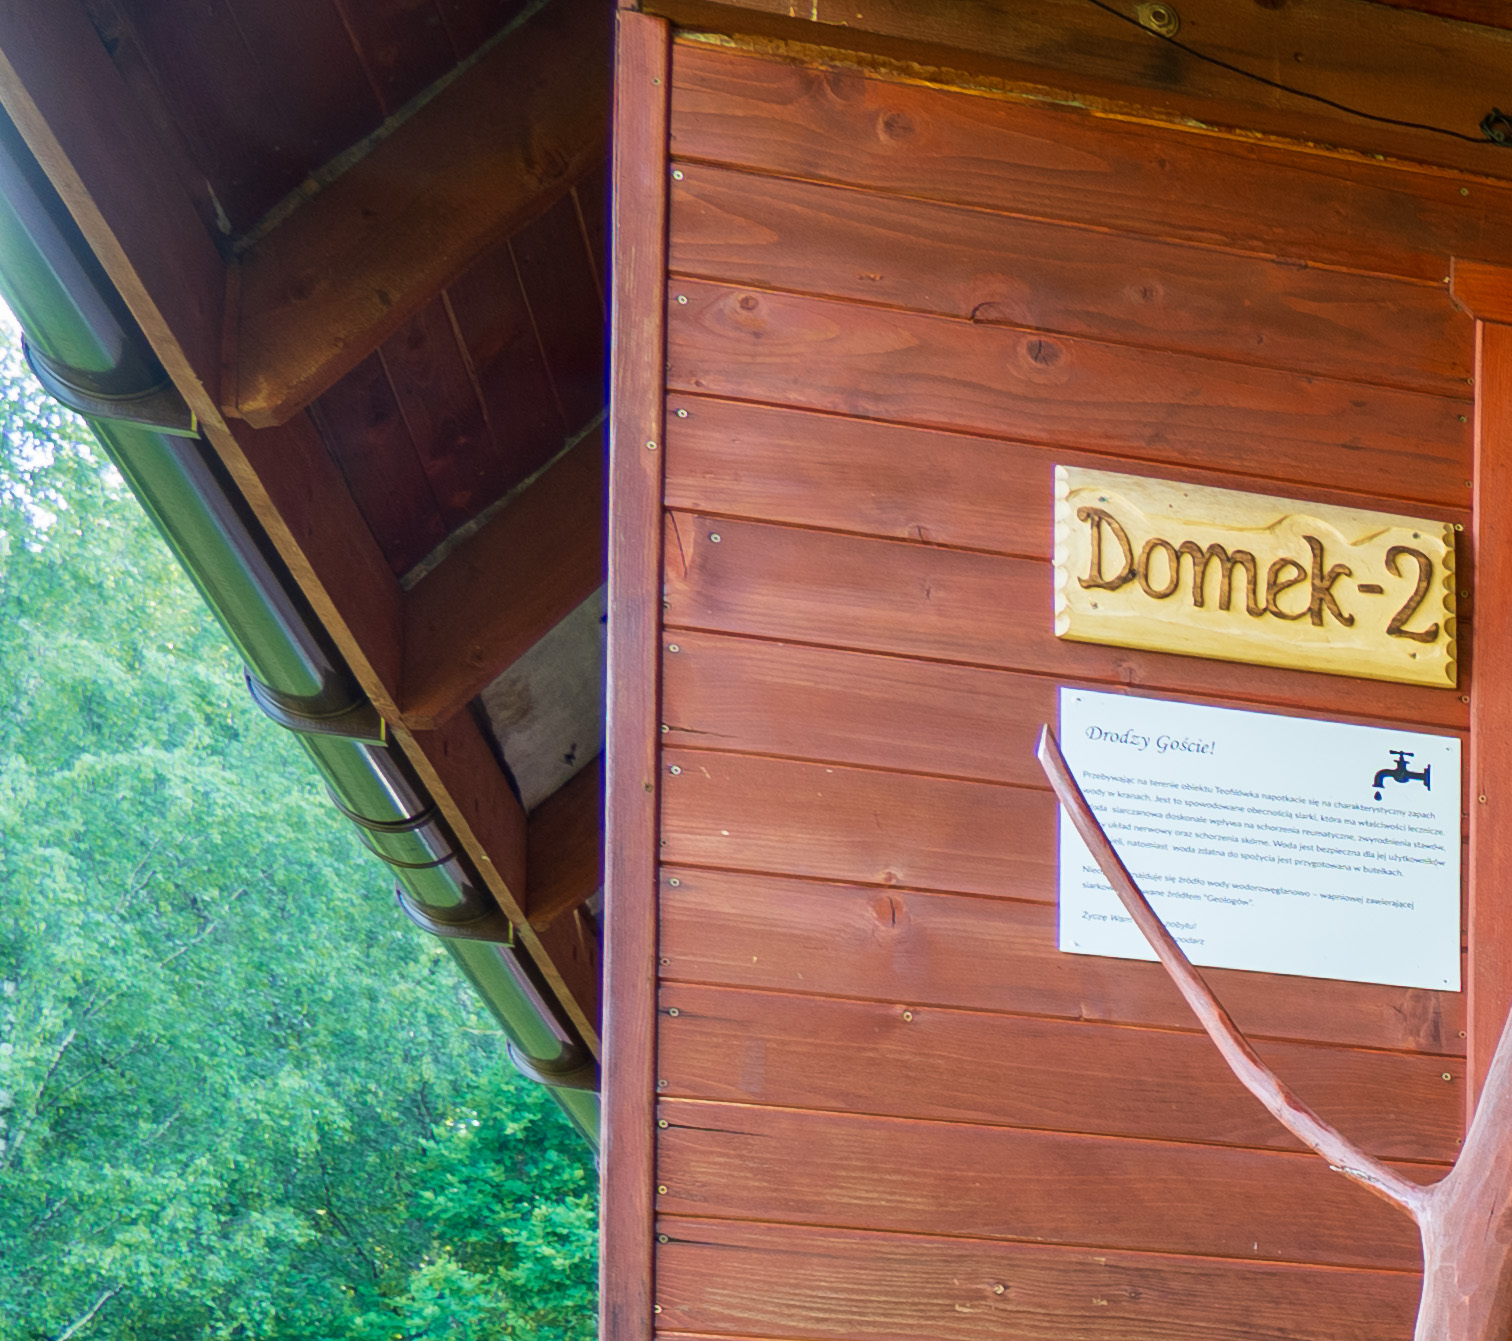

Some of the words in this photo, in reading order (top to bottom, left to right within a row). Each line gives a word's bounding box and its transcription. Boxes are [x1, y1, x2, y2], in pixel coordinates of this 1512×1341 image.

[1077, 506, 1440, 643] Domek-2
[1085, 725, 1150, 751] Drodzy
[1156, 735, 1216, 755] Goście!
